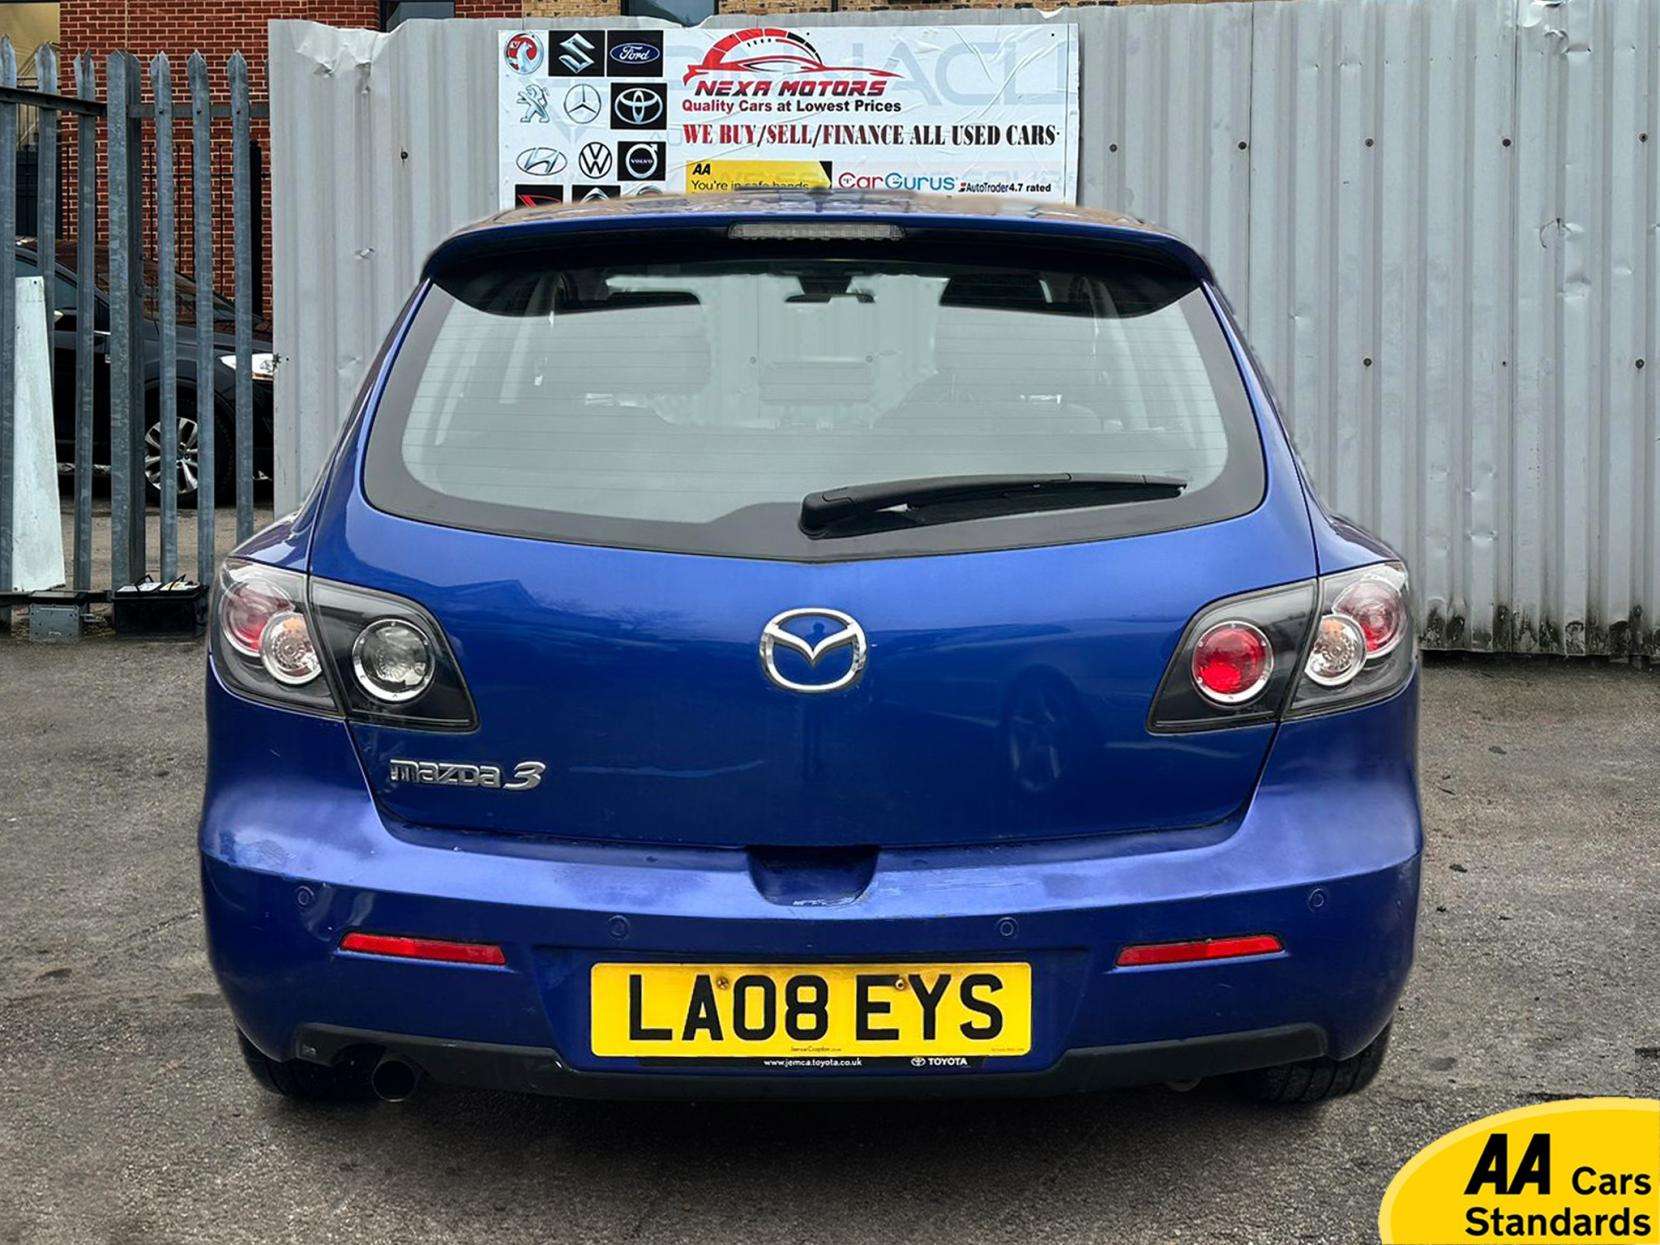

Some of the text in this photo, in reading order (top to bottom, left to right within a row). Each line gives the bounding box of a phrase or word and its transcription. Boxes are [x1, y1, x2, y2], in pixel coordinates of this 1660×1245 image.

[619, 45, 650, 61] Ford
[694, 80, 887, 97] NEXA MOTORS
[682, 99, 902, 114] Quality Cars at Lowest Prices
[683, 124, 713, 144] WE
[910, 125, 946, 145] ALL
[952, 125, 1001, 145] USED
[1006, 125, 1056, 145] CARS
[692, 163, 711, 175] AA
[691, 180, 728, 191] You're
[838, 172, 955, 190] CarGurus
[1009, 183, 1023, 192] 4.7
[1026, 183, 1051, 192] rated
[502, 761, 546, 790] 3
[629, 974, 1004, 1041] LA08 EYS
[763, 1057, 862, 1067] www.jemca.toyota.co.uk
[928, 1057, 968, 1066] TOYOTA
